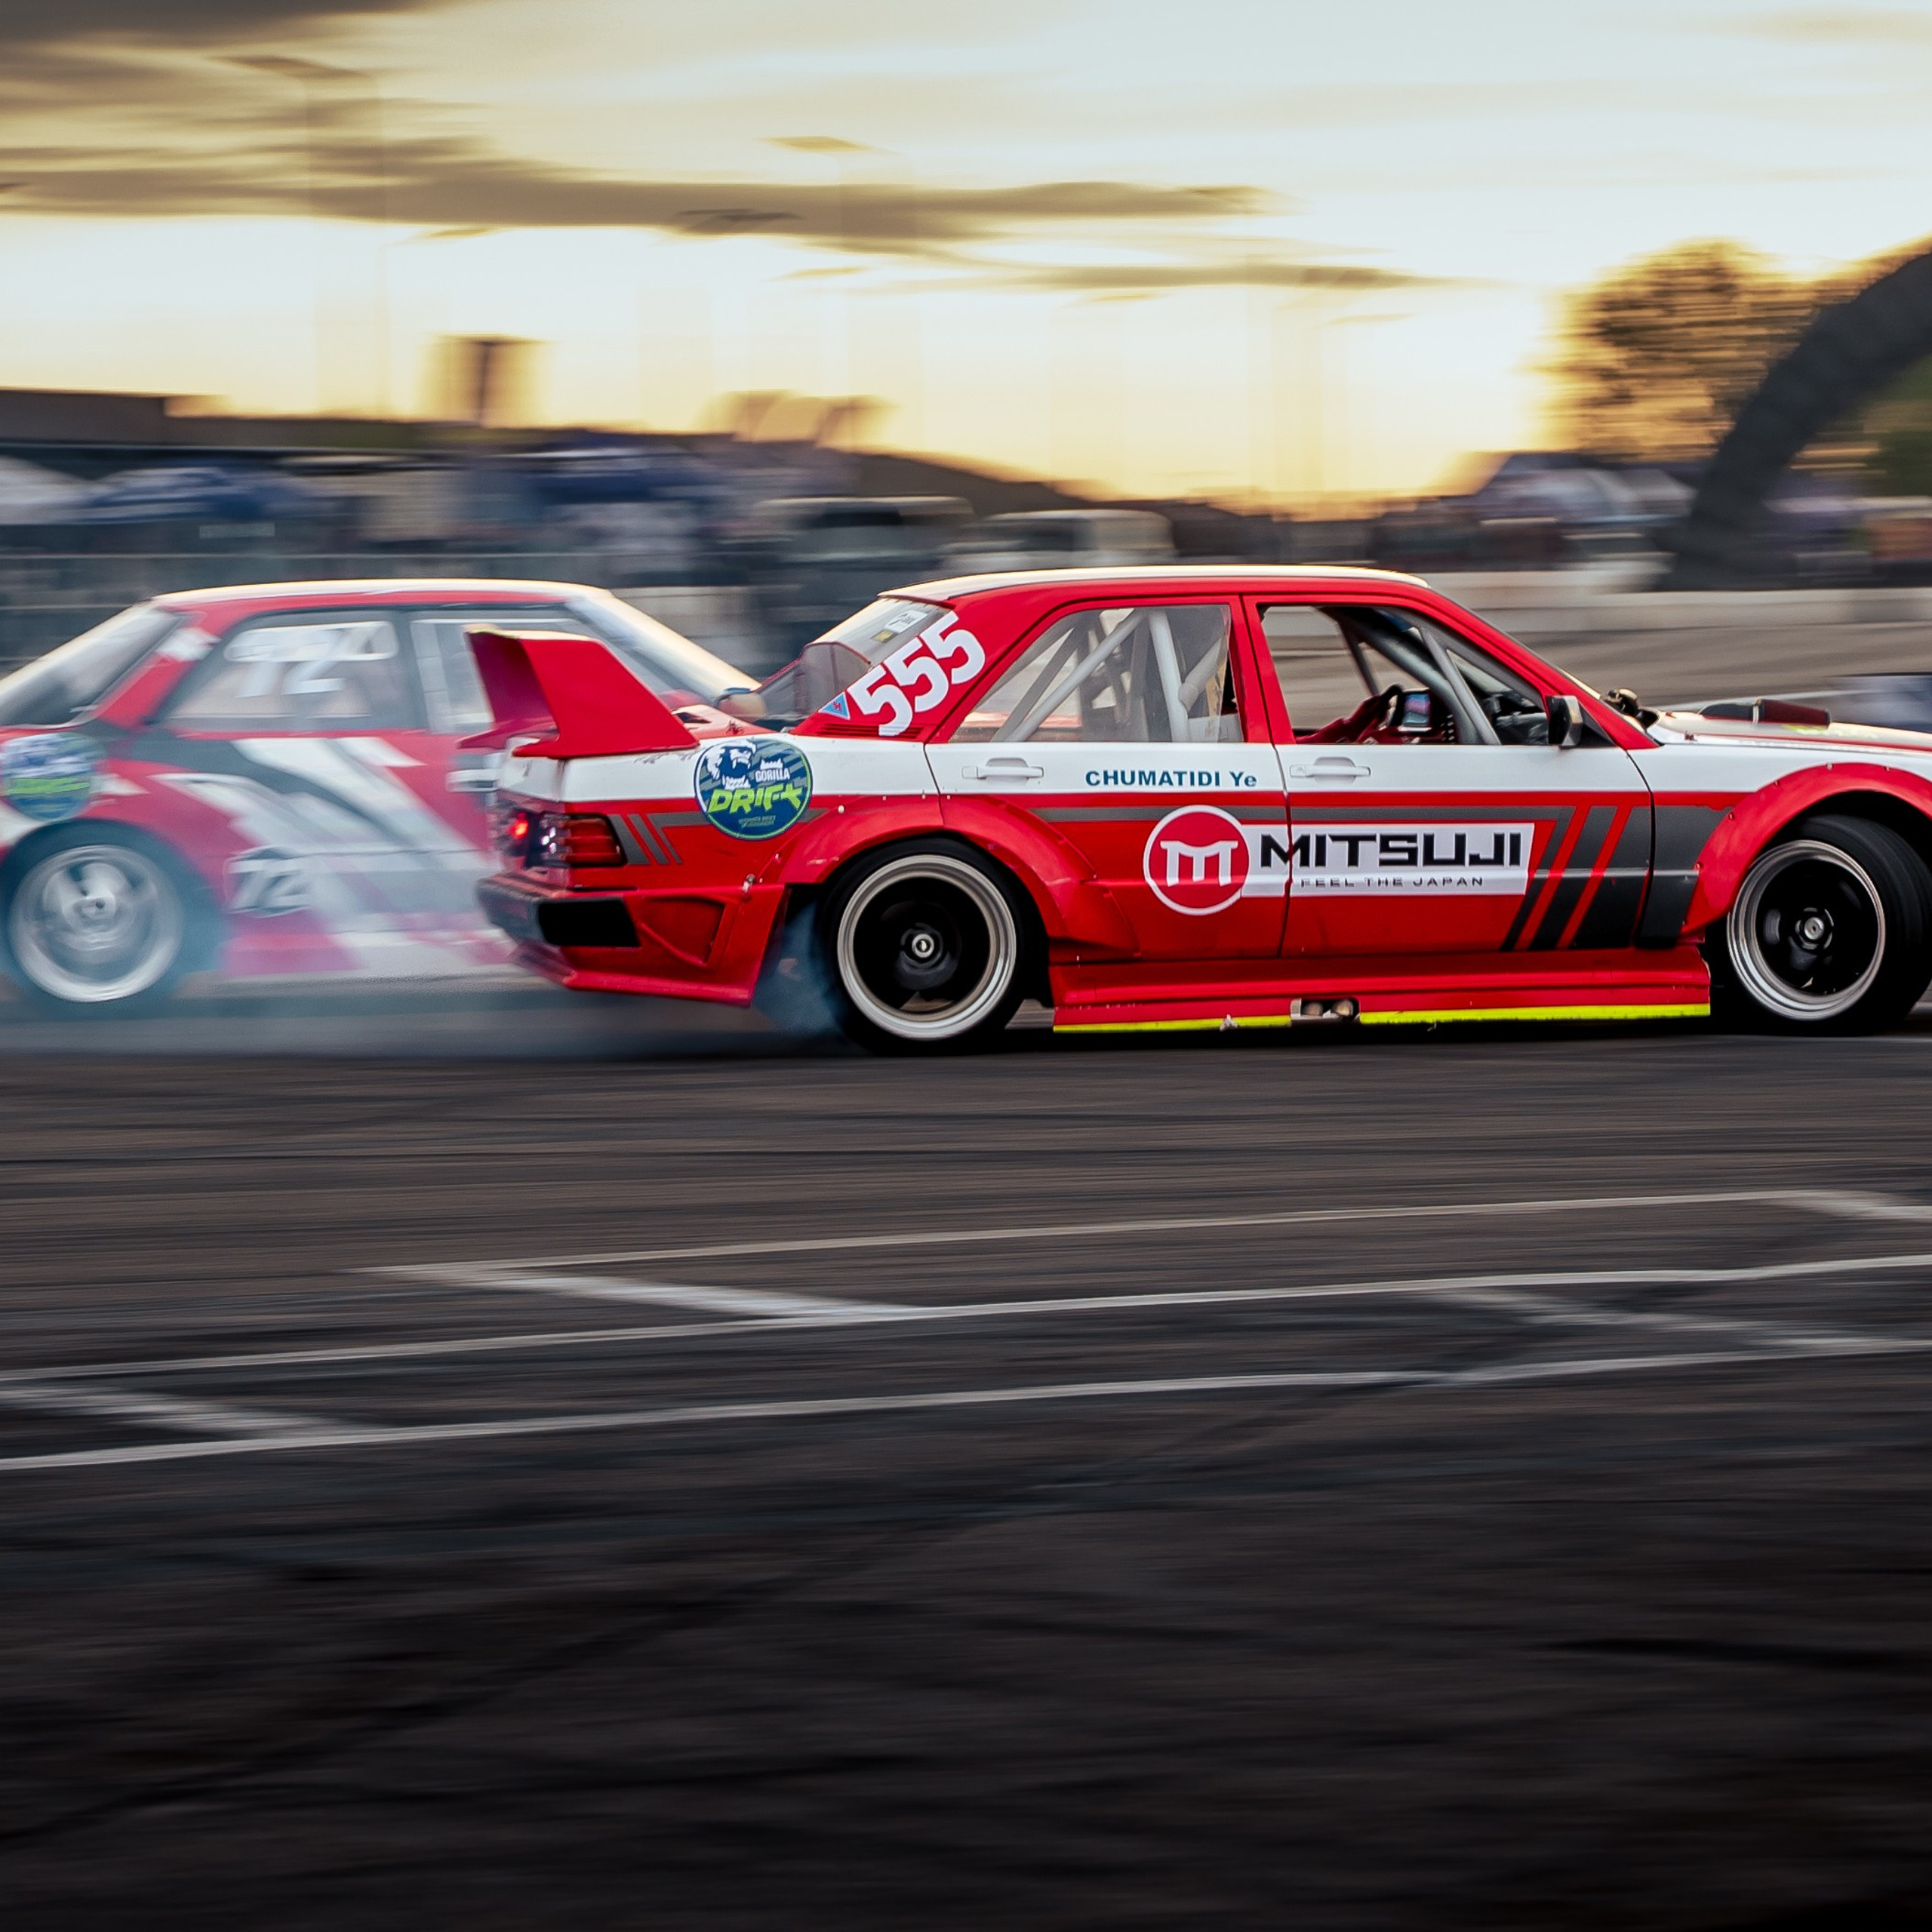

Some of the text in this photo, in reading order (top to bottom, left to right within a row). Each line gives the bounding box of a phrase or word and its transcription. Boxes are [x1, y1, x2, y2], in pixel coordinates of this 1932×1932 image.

[847, 610, 986, 737] 555
[755, 768, 791, 783] GORILLA
[1085, 771, 1257, 787] CHUMATIDI Ye
[707, 783, 802, 814] DRIFT
[1260, 833, 1521, 867] MITSUJI
[1300, 876, 1484, 888] FEEL THE JAPAN
